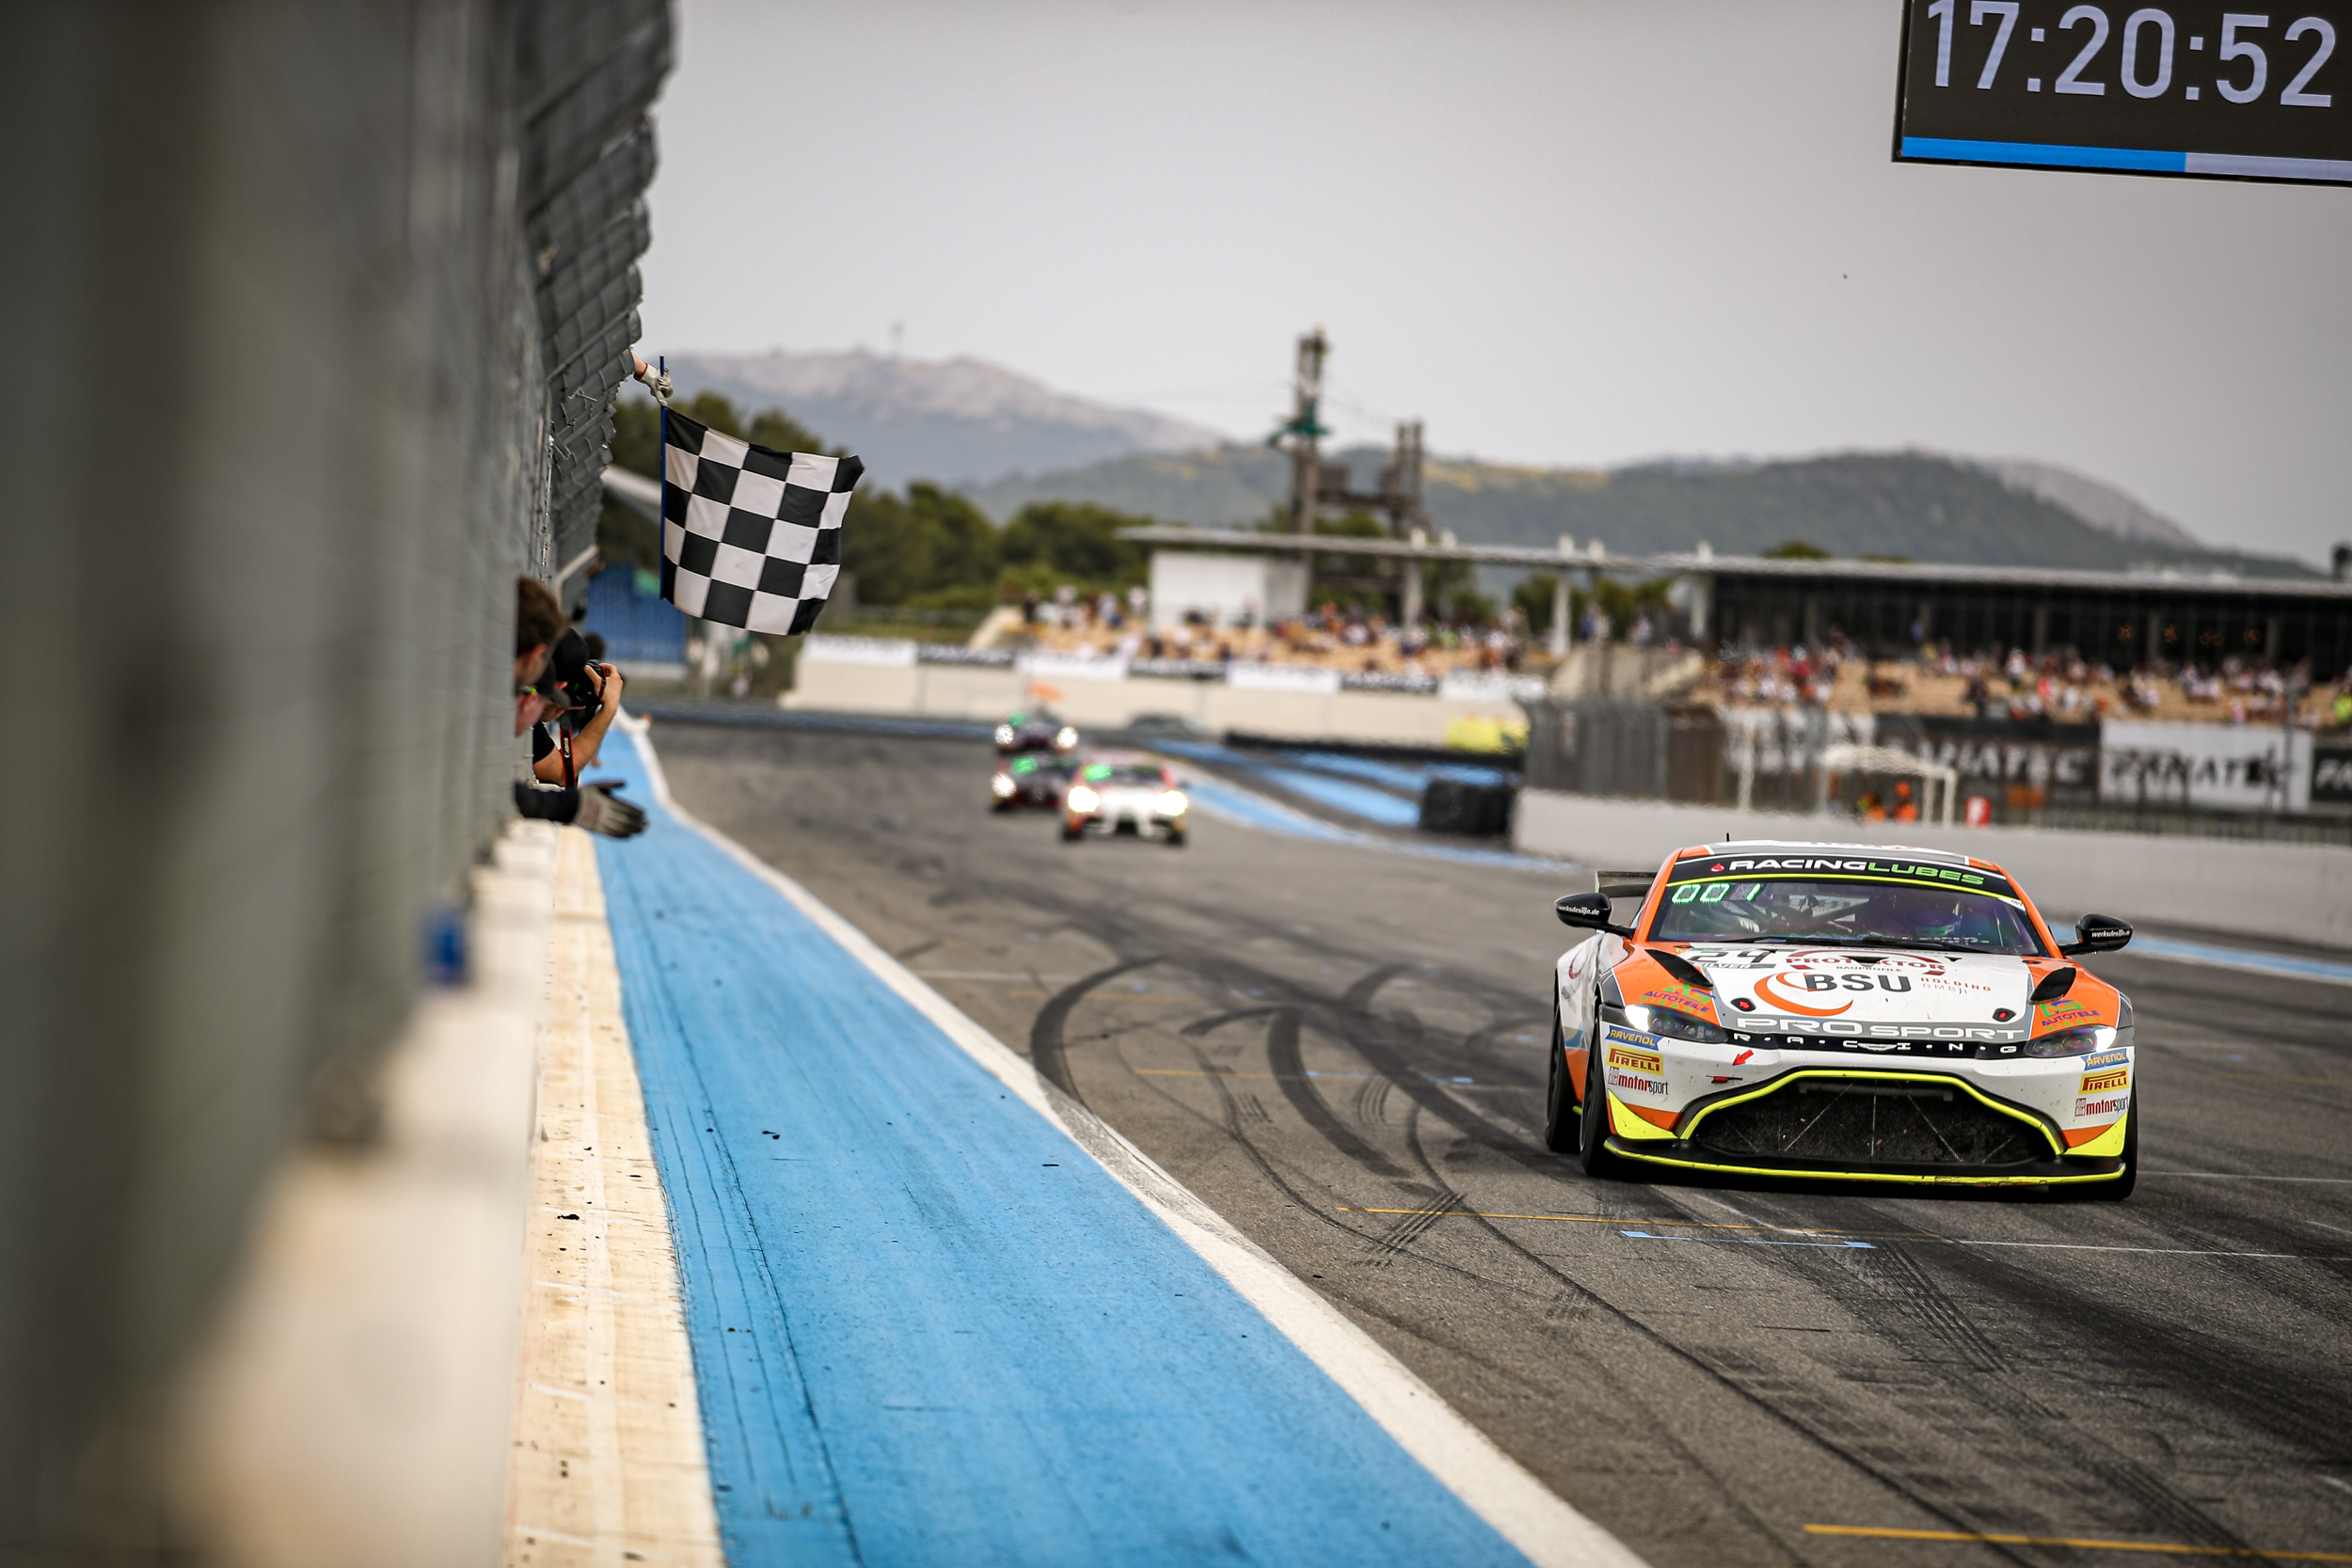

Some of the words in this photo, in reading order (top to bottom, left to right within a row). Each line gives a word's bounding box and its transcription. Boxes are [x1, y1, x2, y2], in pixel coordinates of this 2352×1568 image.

[1928, 0, 2337, 108] 17:20:52
[1671, 882, 1762, 905] 001
[1688, 950, 1772, 964] 24
[1785, 958, 1947, 971] PROTKTOR
[1804, 974, 1913, 993] BSU
[1920, 977, 1992, 991] HOLDING
[1644, 990, 1710, 1013] AUTOTEILE
[2042, 1009, 2100, 1027] AUTOTEILE
[1610, 1029, 1656, 1047] RAVENOL
[1609, 1048, 1661, 1072] PIRELLI
[2086, 1052, 2126, 1067] RAVENOL
[1618, 1074, 1669, 1096] motorsport
[2082, 1070, 2127, 1091] PIRELLI
[2086, 1095, 2129, 1116] motorsport
